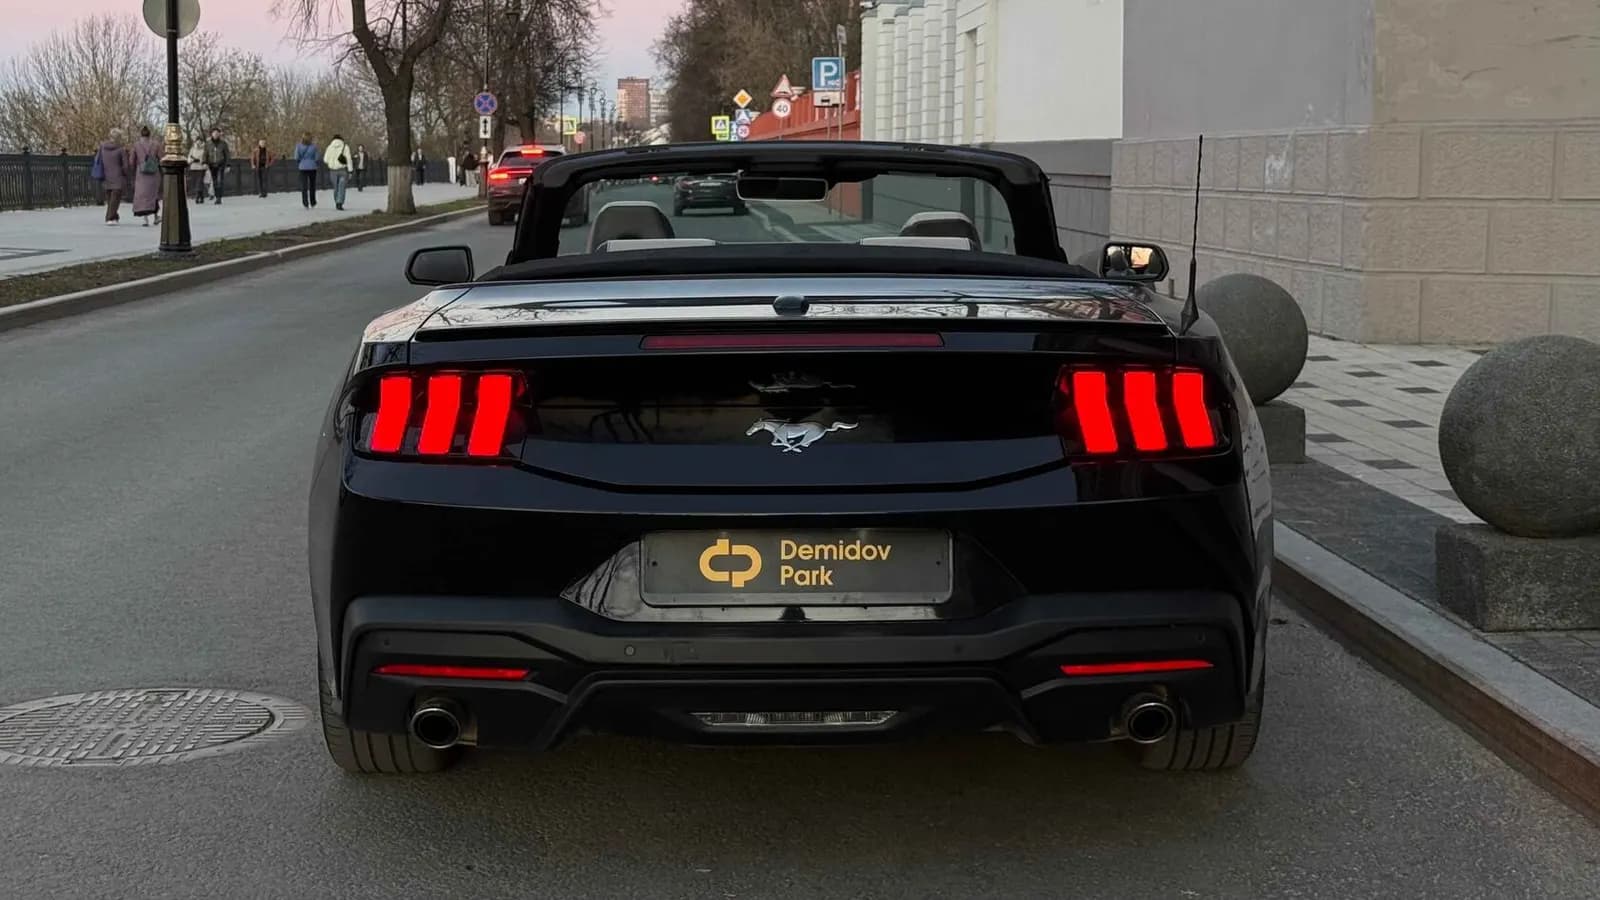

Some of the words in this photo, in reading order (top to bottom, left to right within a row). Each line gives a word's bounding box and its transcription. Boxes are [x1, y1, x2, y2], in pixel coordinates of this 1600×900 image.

[820, 61, 838, 87] P
[776, 104, 789, 114] 40
[780, 539, 890, 561] Demidov
[780, 564, 832, 586] Park
